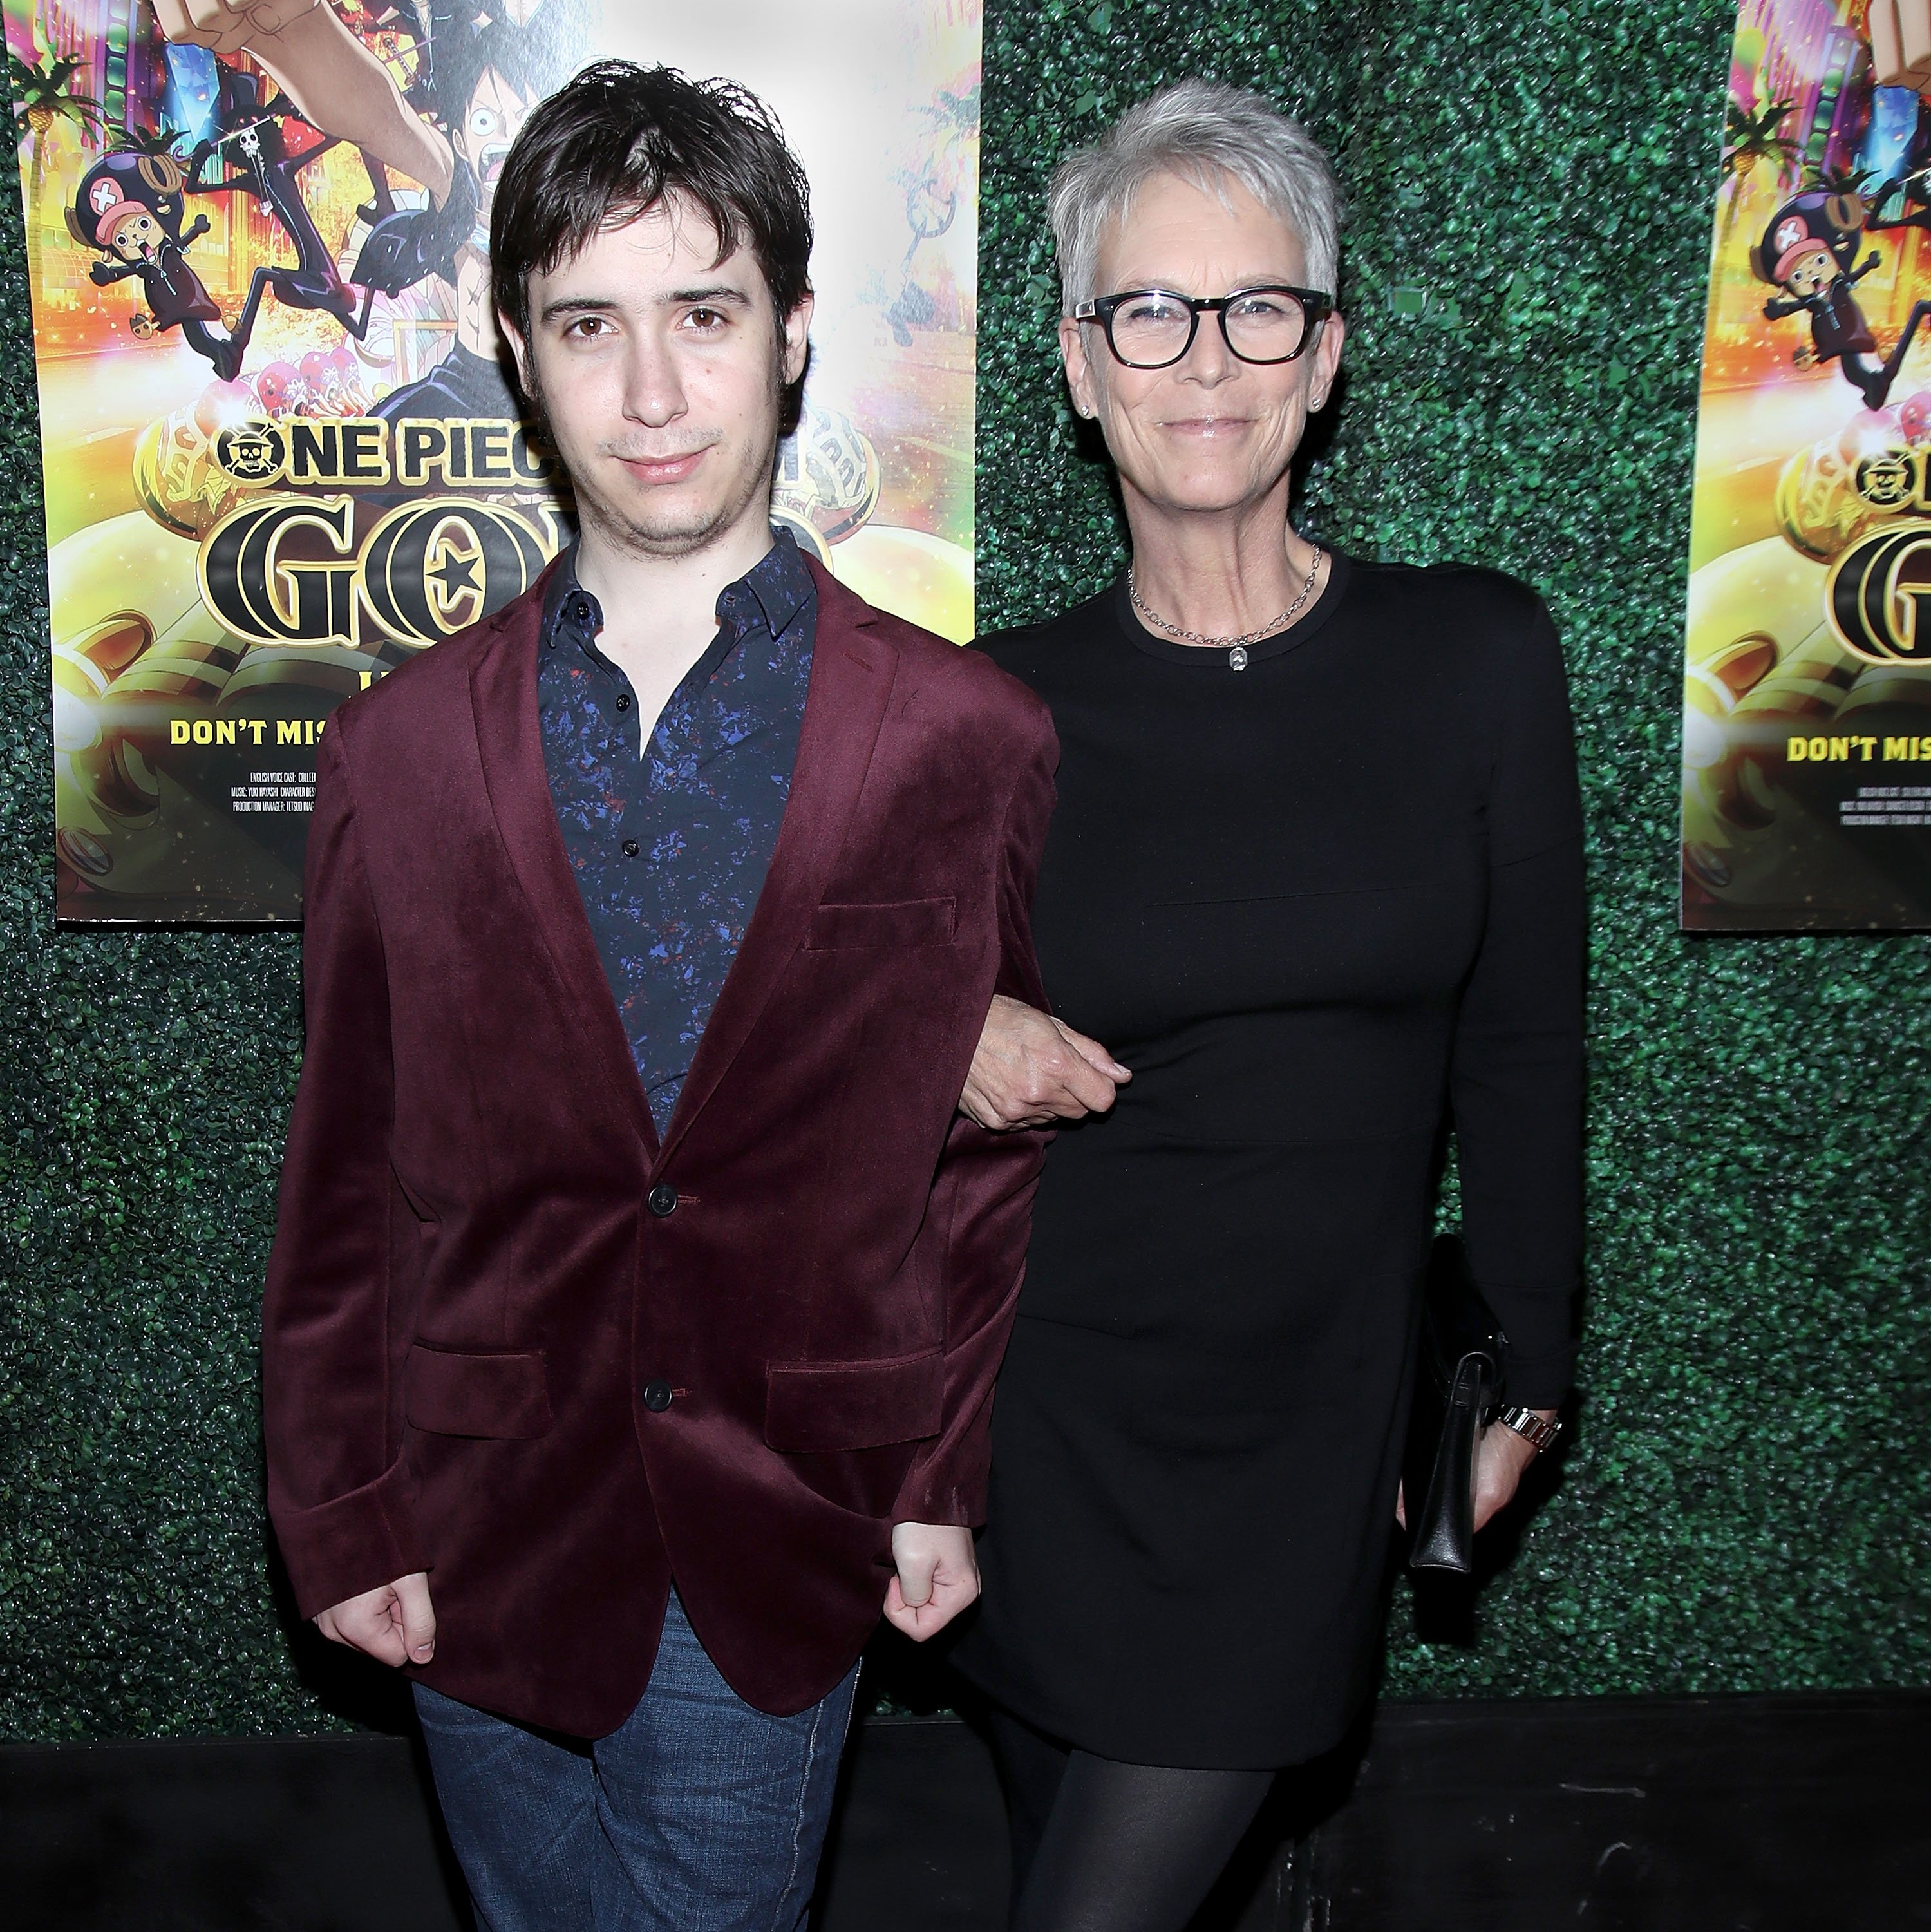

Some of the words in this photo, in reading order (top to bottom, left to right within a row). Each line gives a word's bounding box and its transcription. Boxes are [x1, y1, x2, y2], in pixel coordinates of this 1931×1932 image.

[214, 419, 388, 483] ONE
[398, 420, 559, 484] PIEC
[170, 718, 267, 744] DON'T
[1787, 735, 1878, 762] DON'T
[1882, 736, 1931, 761] MIS
[250, 772, 270, 783] ENGLISH
[270, 772, 283, 783] VOICE
[231, 786, 248, 797] MUSIC:
[259, 786, 278, 797] HAYASHI
[280, 786, 306, 797] CHARACTER
[306, 786, 316, 797] DES
[232, 800, 261, 812] PRODUCTION
